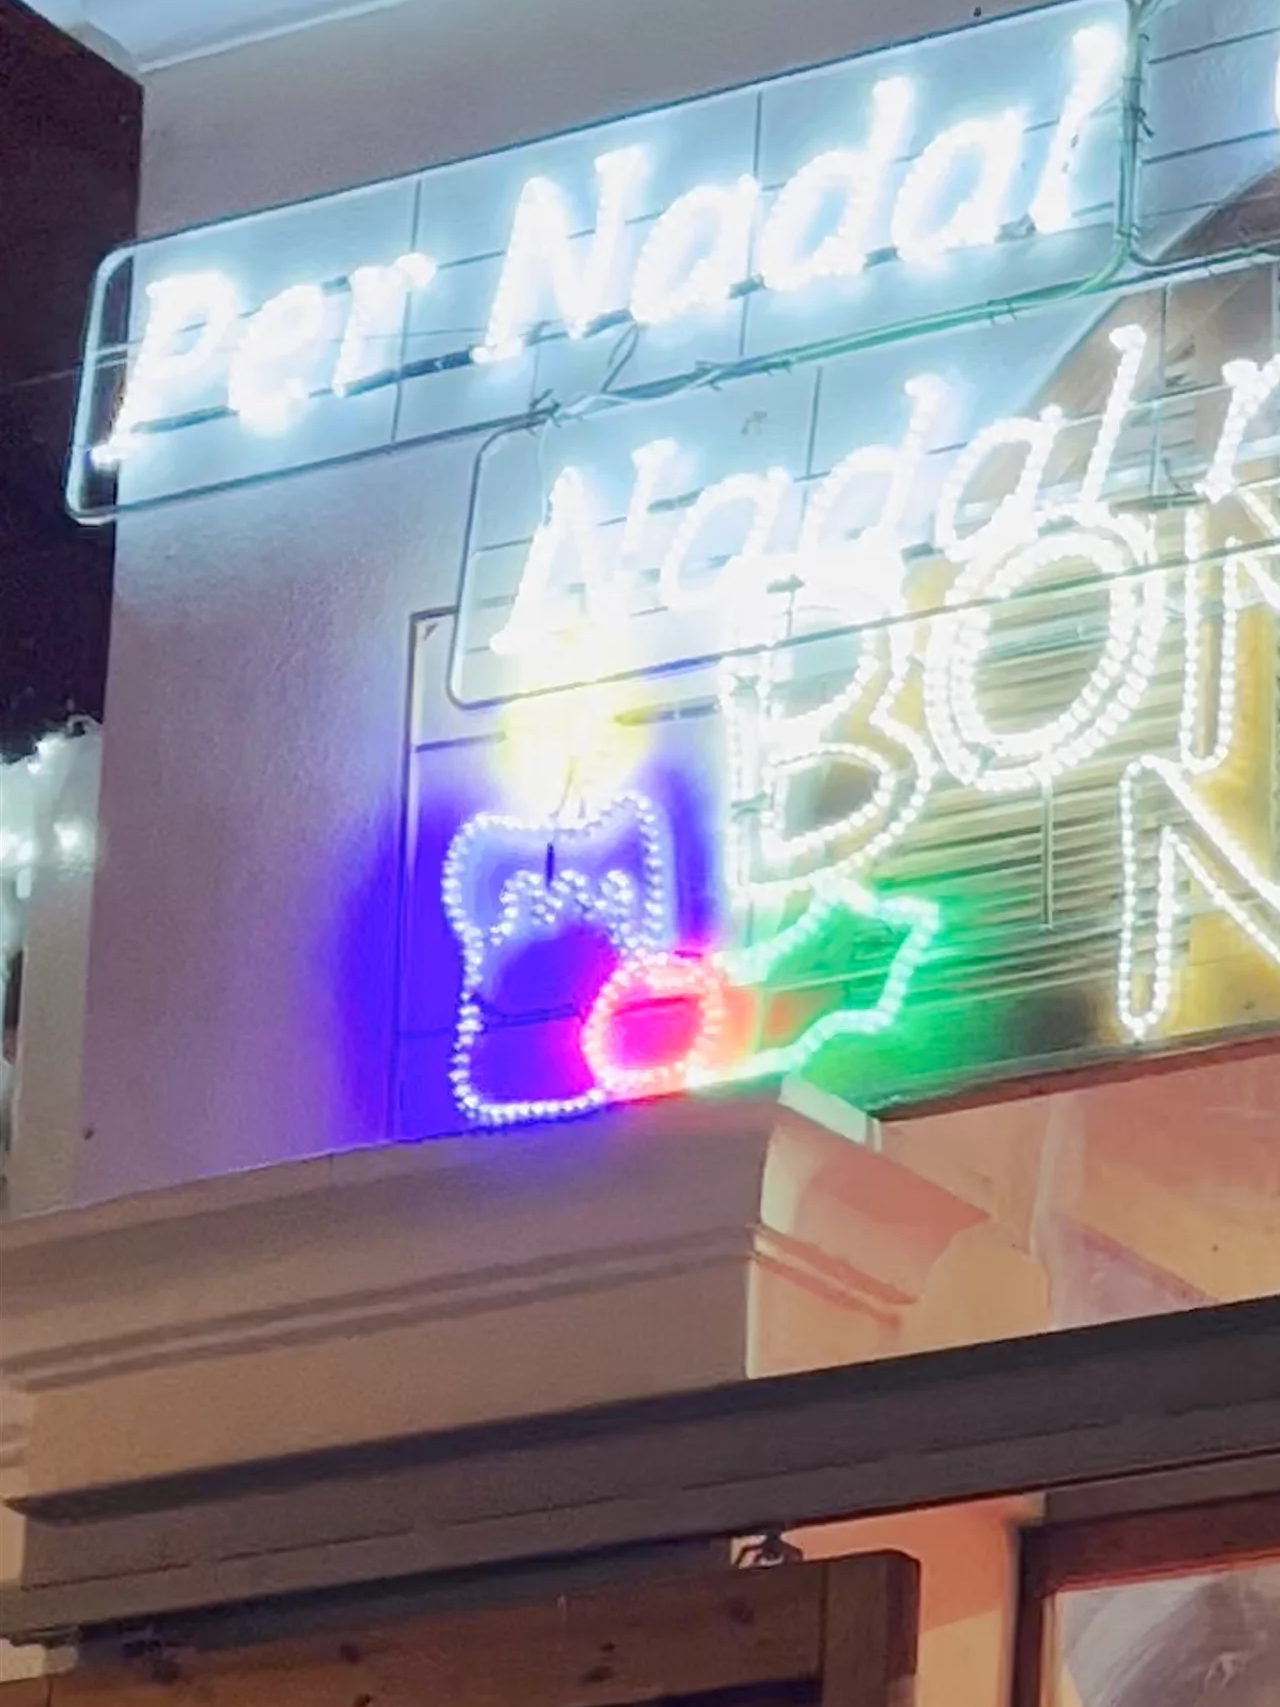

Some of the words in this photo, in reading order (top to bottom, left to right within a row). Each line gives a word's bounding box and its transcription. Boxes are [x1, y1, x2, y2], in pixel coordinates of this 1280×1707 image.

[90, 248, 438, 469] Per
[470, 23, 1130, 367] Nadal
[488, 323, 1150, 655] Nadal
